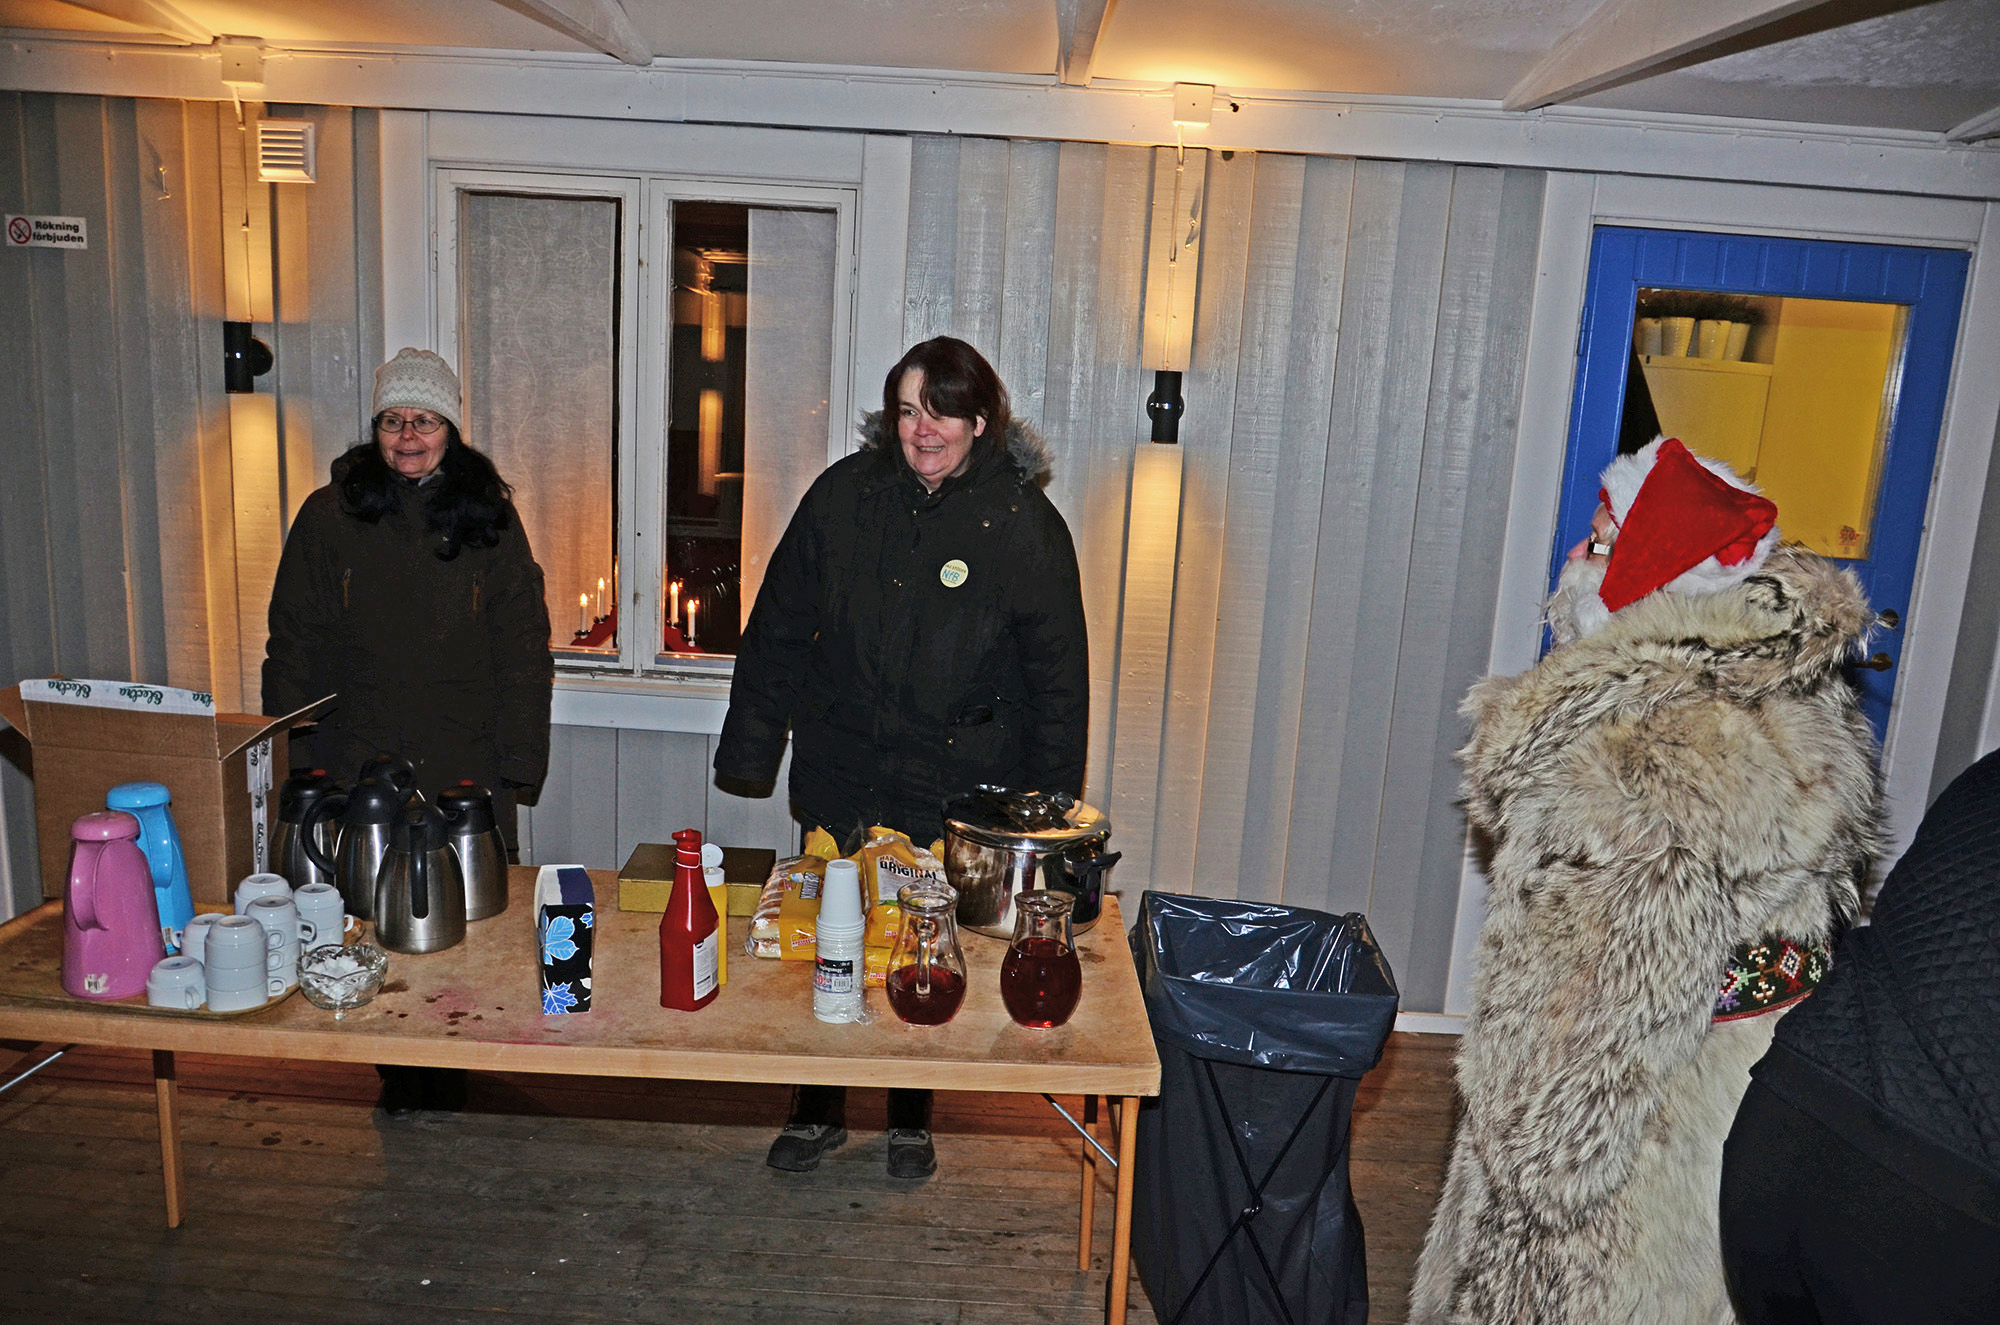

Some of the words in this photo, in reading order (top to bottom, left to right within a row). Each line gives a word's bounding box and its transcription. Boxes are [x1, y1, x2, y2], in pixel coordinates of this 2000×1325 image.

[35, 221, 79, 233] Rökning
[33, 233, 84, 243] förbjuden
[48, 680, 91, 698] Electra
[119, 687, 163, 705] Electra
[880, 861, 937, 881] ORIGINAL
